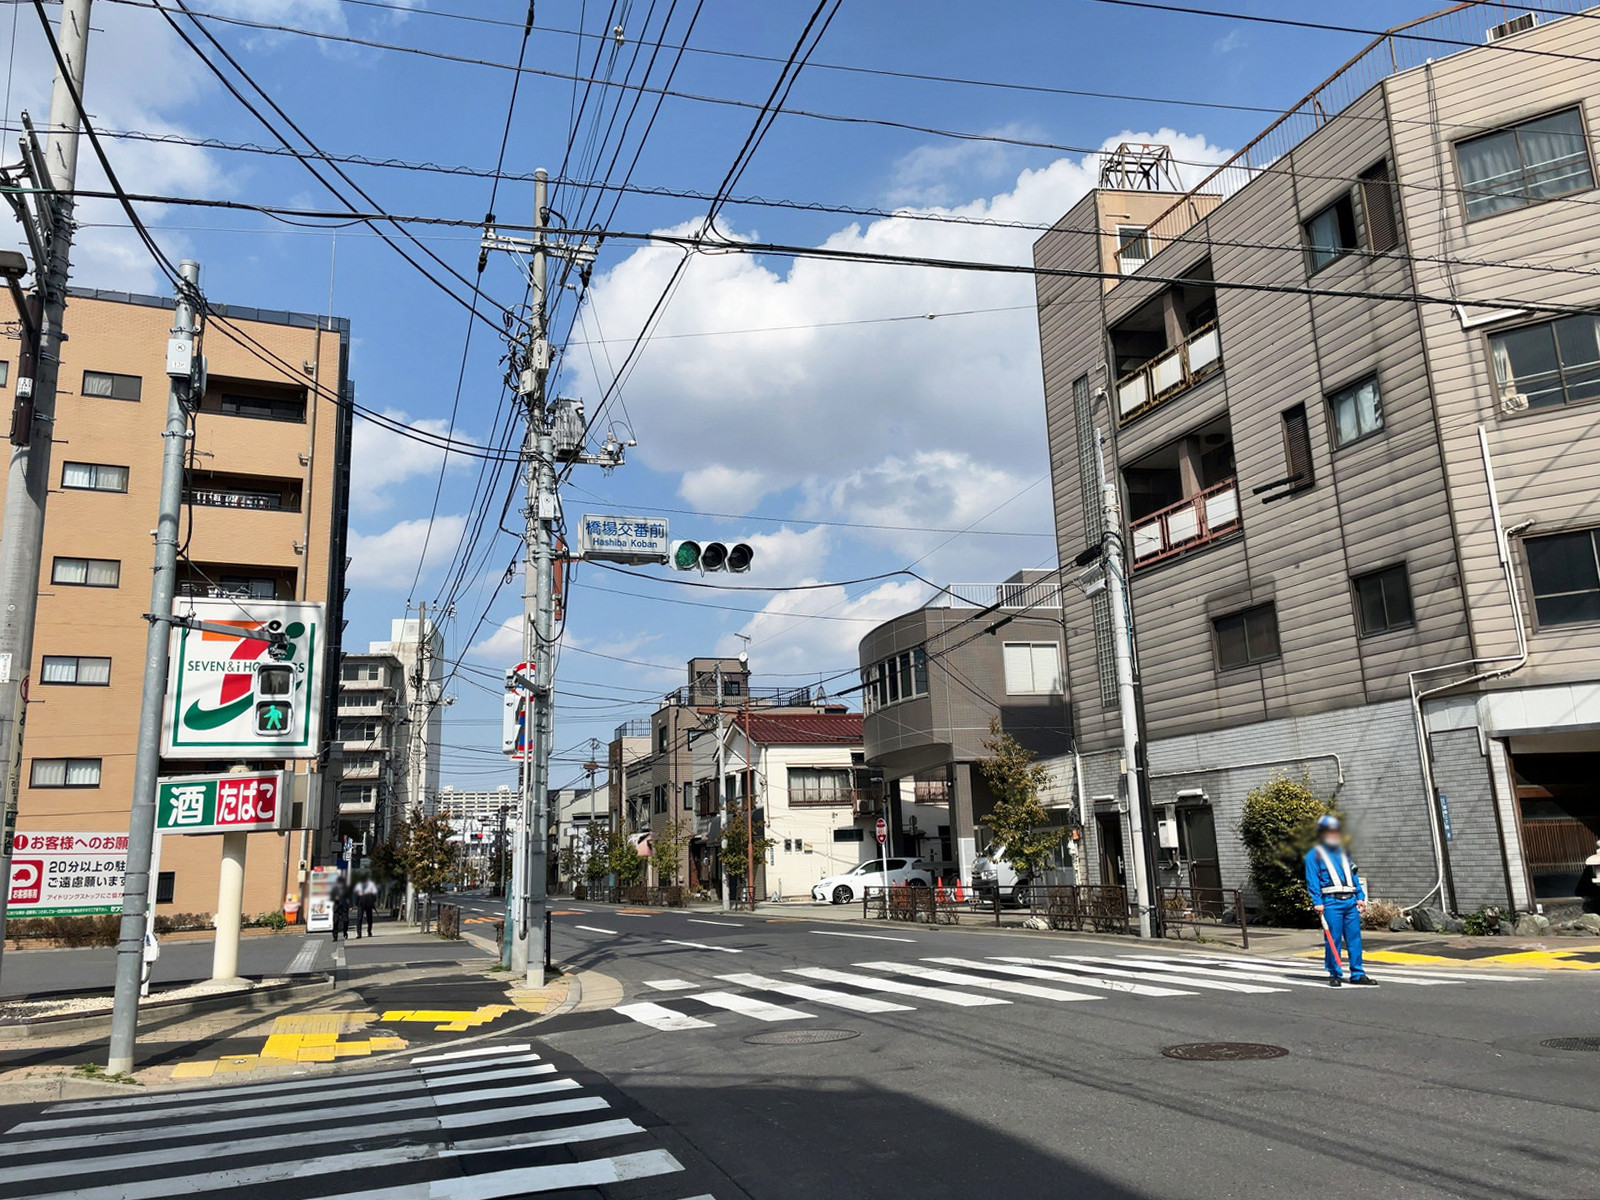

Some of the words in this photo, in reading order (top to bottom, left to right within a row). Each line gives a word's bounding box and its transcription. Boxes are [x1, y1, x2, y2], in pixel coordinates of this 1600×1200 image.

[586, 520, 664, 538] 橋場交番前
[592, 538, 627, 547] Hashiba
[631, 540, 658, 548] Koban
[167, 785, 207, 827] 酒
[218, 781, 273, 822] たばこ
